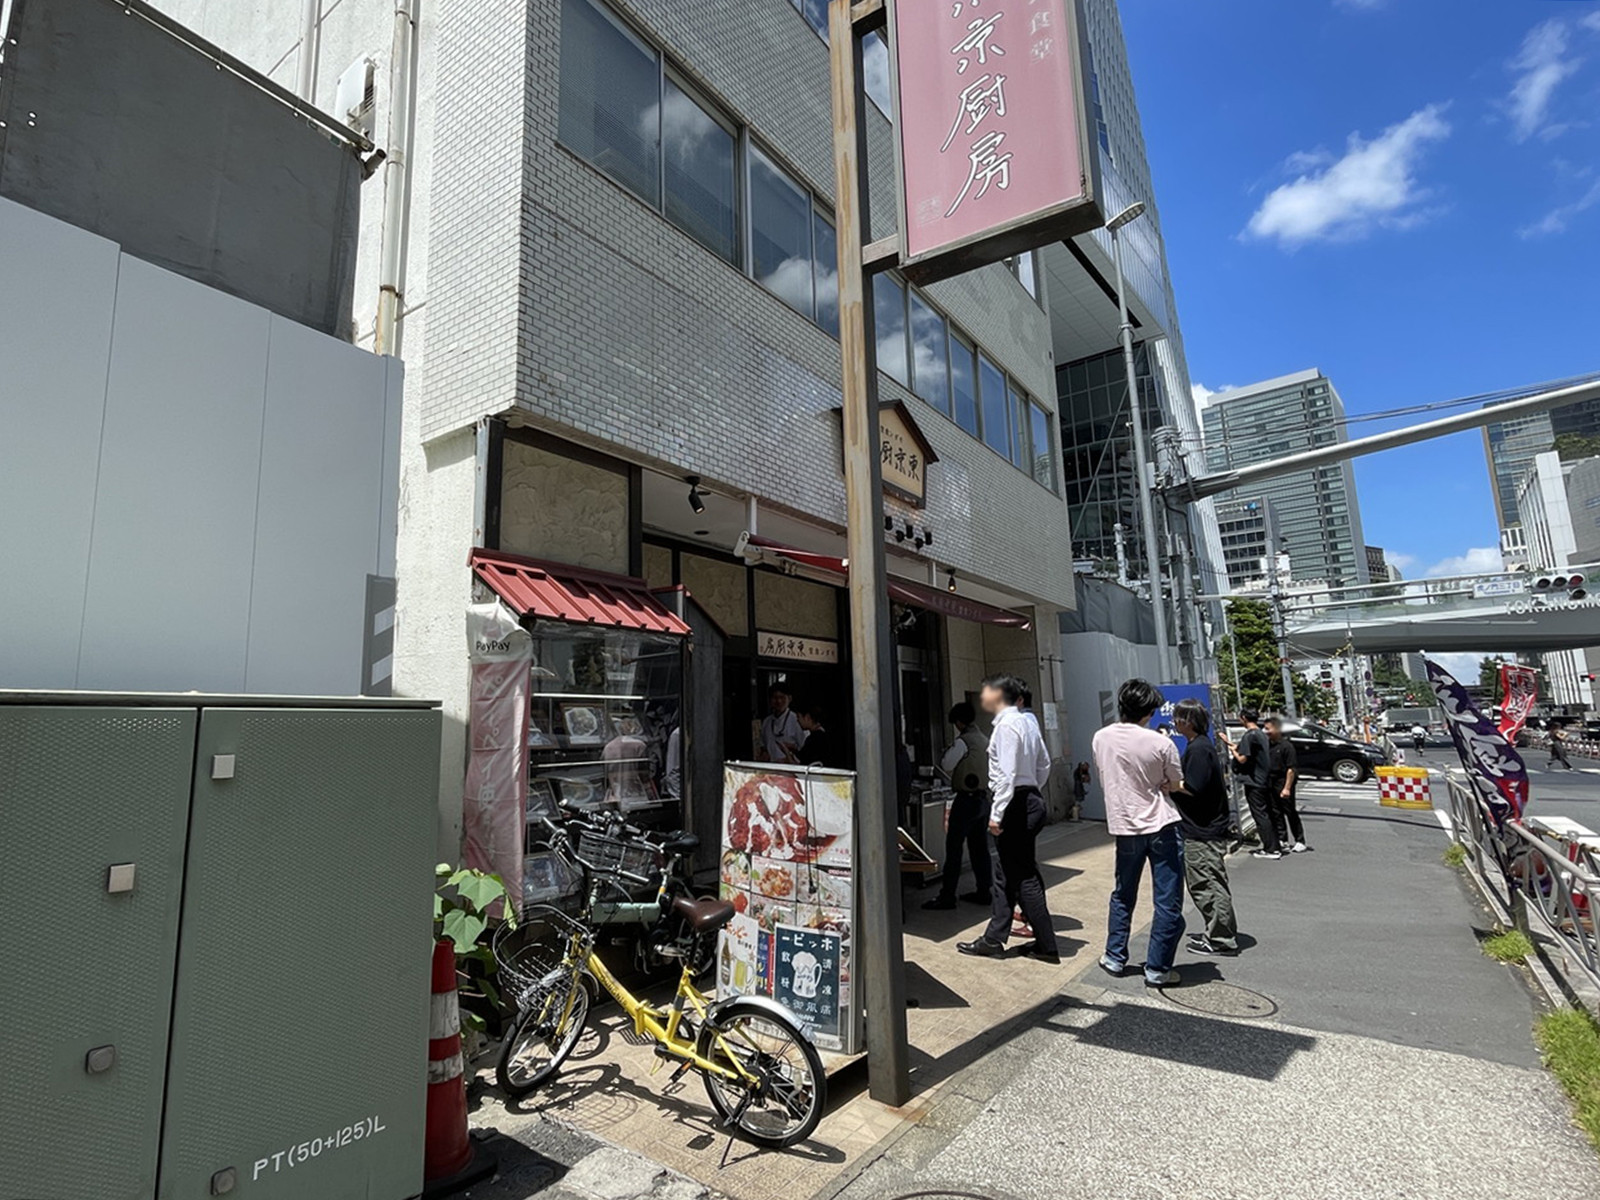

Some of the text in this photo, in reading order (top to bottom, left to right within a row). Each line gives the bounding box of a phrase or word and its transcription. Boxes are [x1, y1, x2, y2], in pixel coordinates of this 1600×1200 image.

[941, 0, 1014, 218] 京厨房
[476, 640, 511, 653] PayPay
